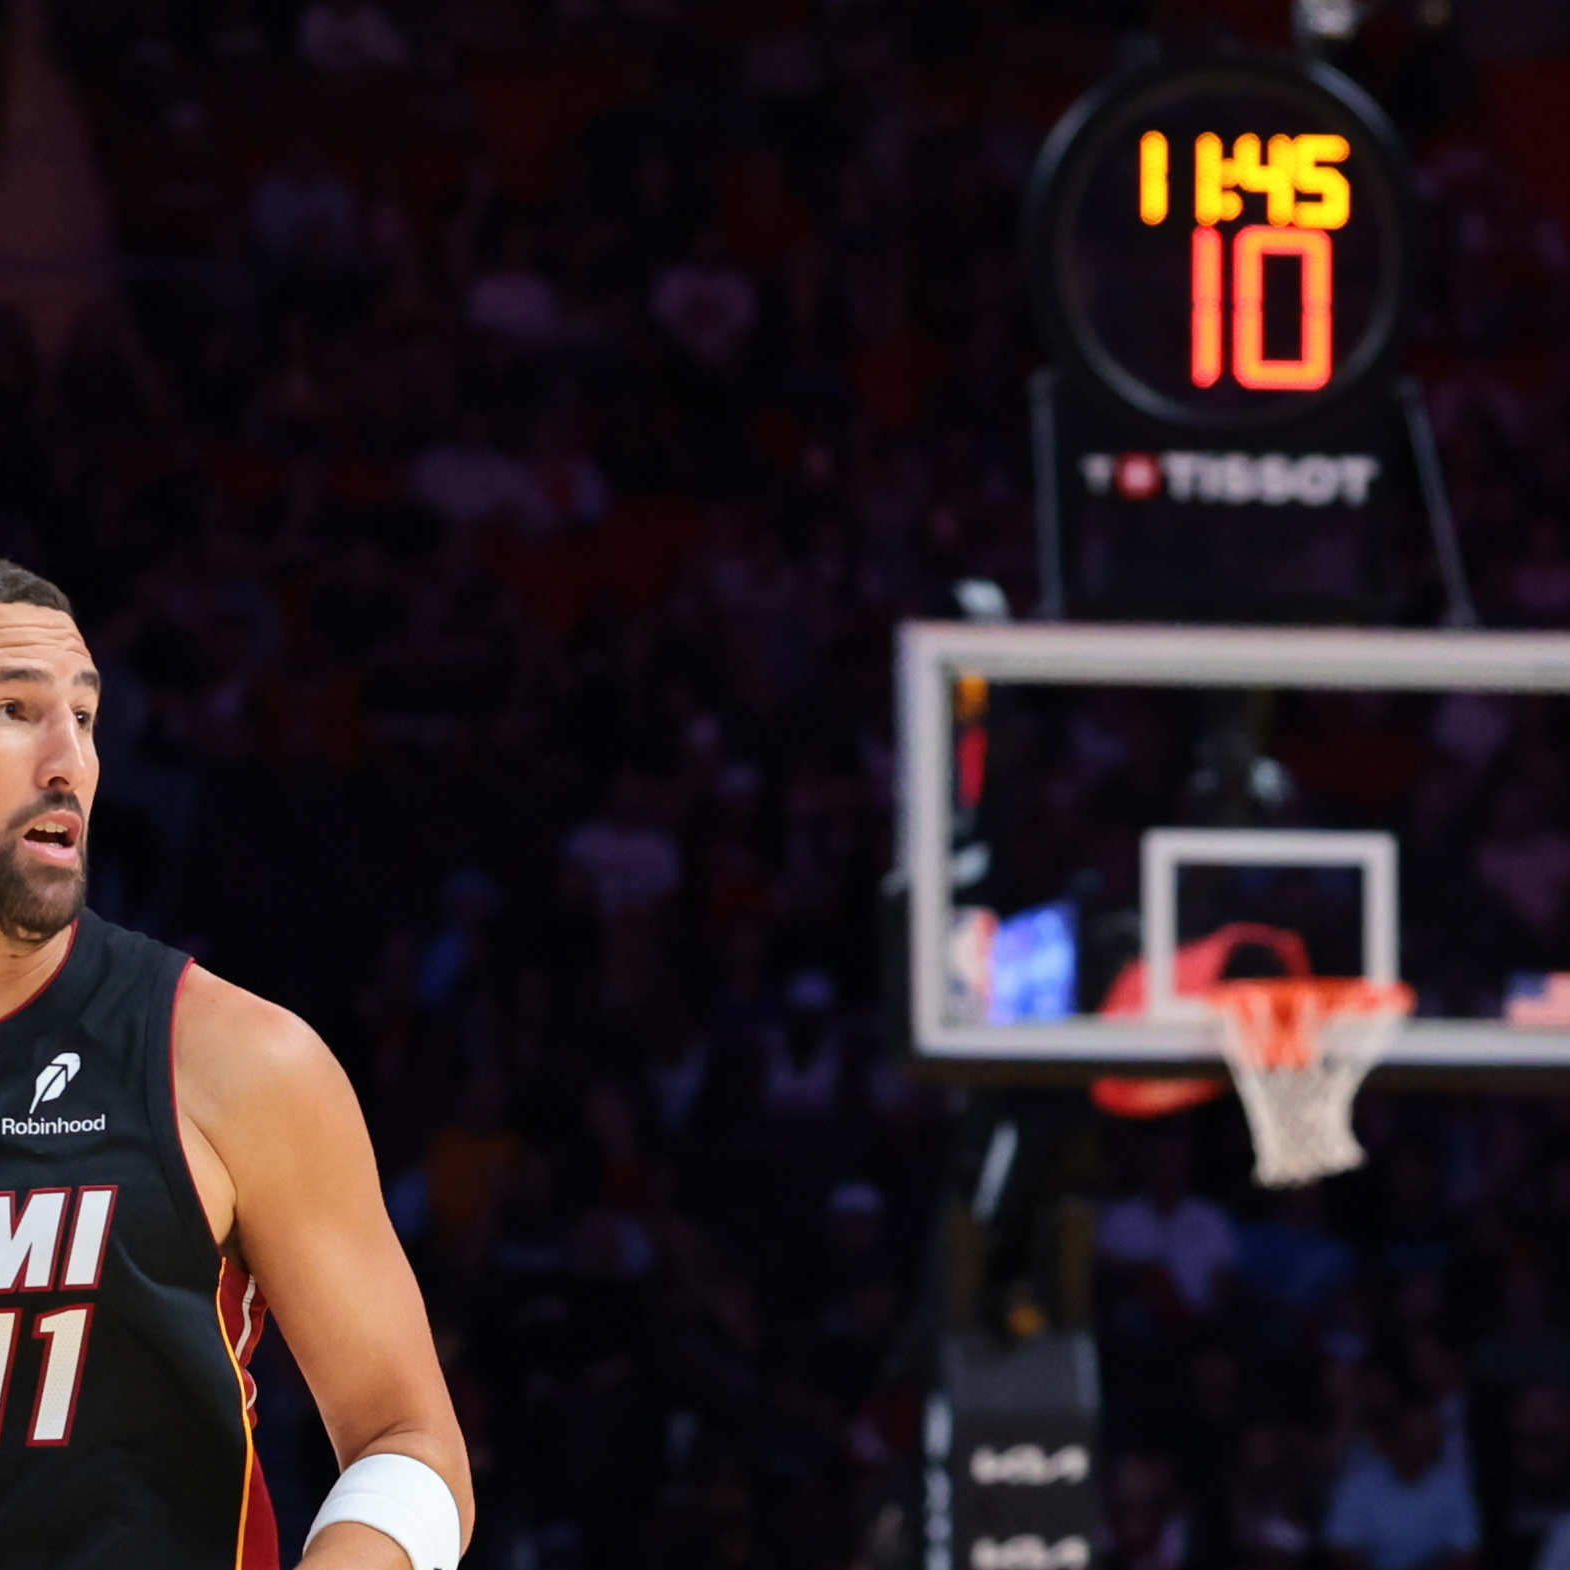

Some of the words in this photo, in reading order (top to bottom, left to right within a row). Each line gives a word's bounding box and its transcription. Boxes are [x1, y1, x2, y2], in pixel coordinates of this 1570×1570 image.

[1139, 130, 1351, 230] 11:45
[1190, 225, 1333, 390] 10
[1161, 454, 1377, 506] TISSOT
[0, 1113, 107, 1136] Robinhood
